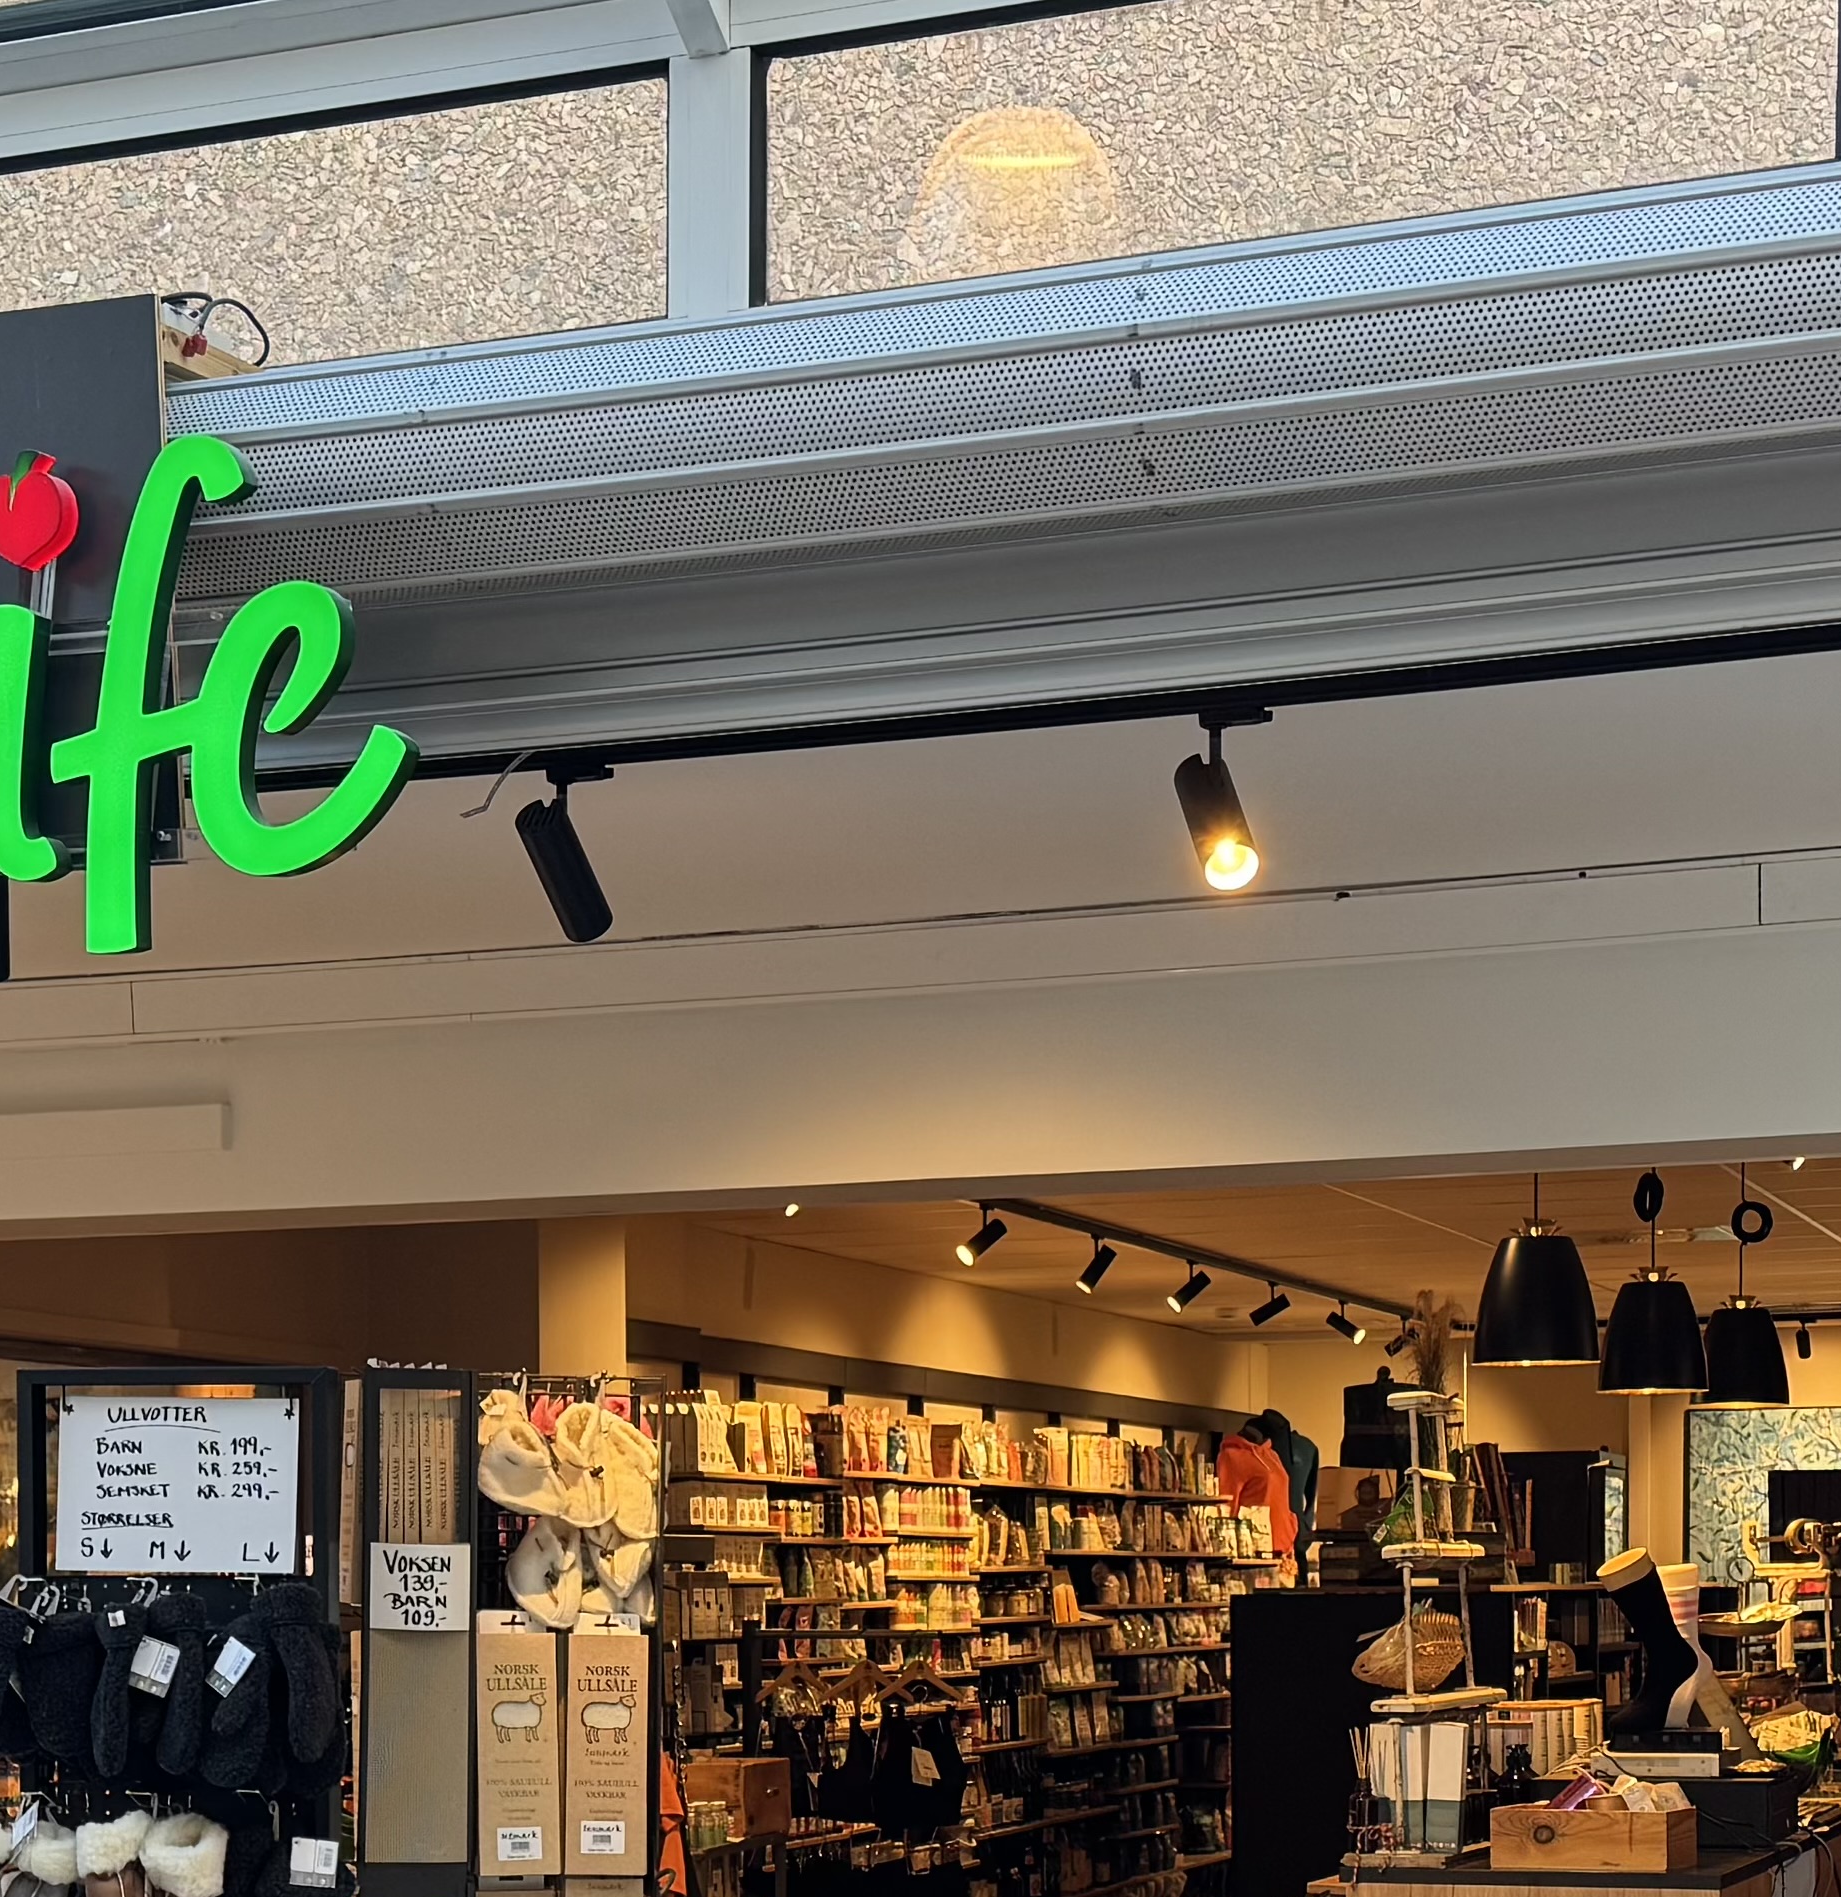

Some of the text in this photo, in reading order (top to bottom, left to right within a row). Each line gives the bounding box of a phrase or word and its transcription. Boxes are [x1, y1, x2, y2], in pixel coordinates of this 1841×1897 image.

[107, 1406, 208, 1424] ULLVOTTER
[96, 1437, 143, 1455] BARN
[96, 1461, 158, 1478] VOKSNE
[96, 1483, 171, 1500] SEMSKET
[80, 1511, 174, 1528] STØRRELSER
[80, 1537, 261, 1562] S M L
[382, 1549, 451, 1575] VOKSEN
[383, 1592, 447, 1610] BARN
[494, 1664, 539, 1676] NORSK
[585, 1665, 631, 1677] NORSK
[486, 1676, 548, 1692] ULLSÅLE
[577, 1678, 638, 1693] ULLSÅLE
